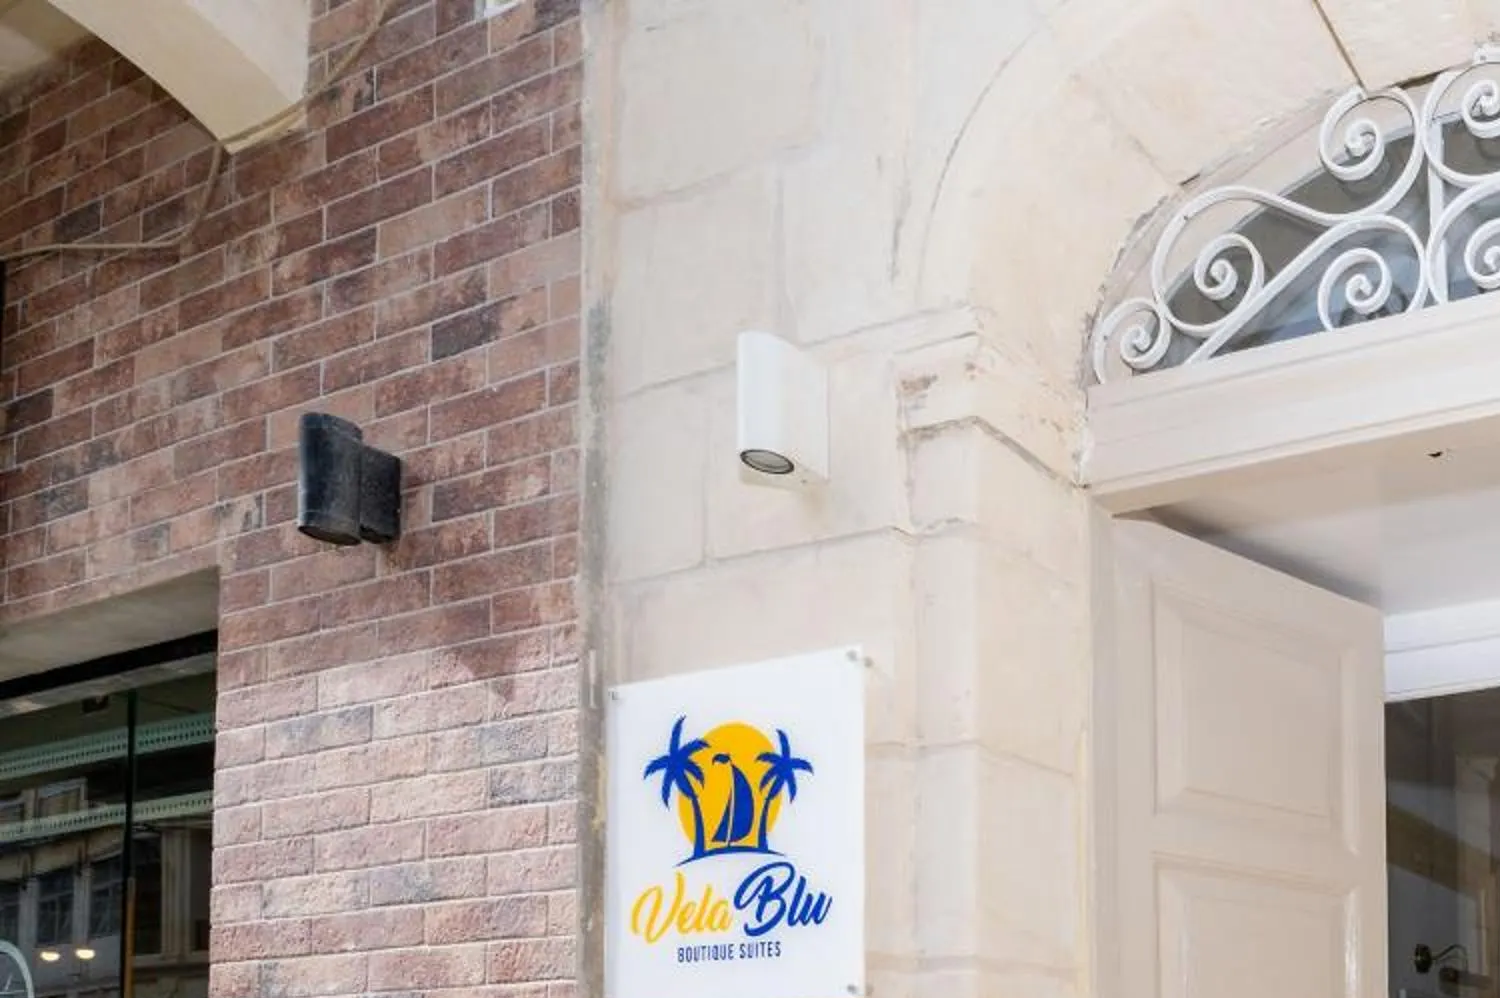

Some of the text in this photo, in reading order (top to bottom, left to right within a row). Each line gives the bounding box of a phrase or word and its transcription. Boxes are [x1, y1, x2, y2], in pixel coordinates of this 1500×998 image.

[630, 861, 833, 944] Vela Blu
[677, 940, 782, 963] BOUTIQUE SUITES
